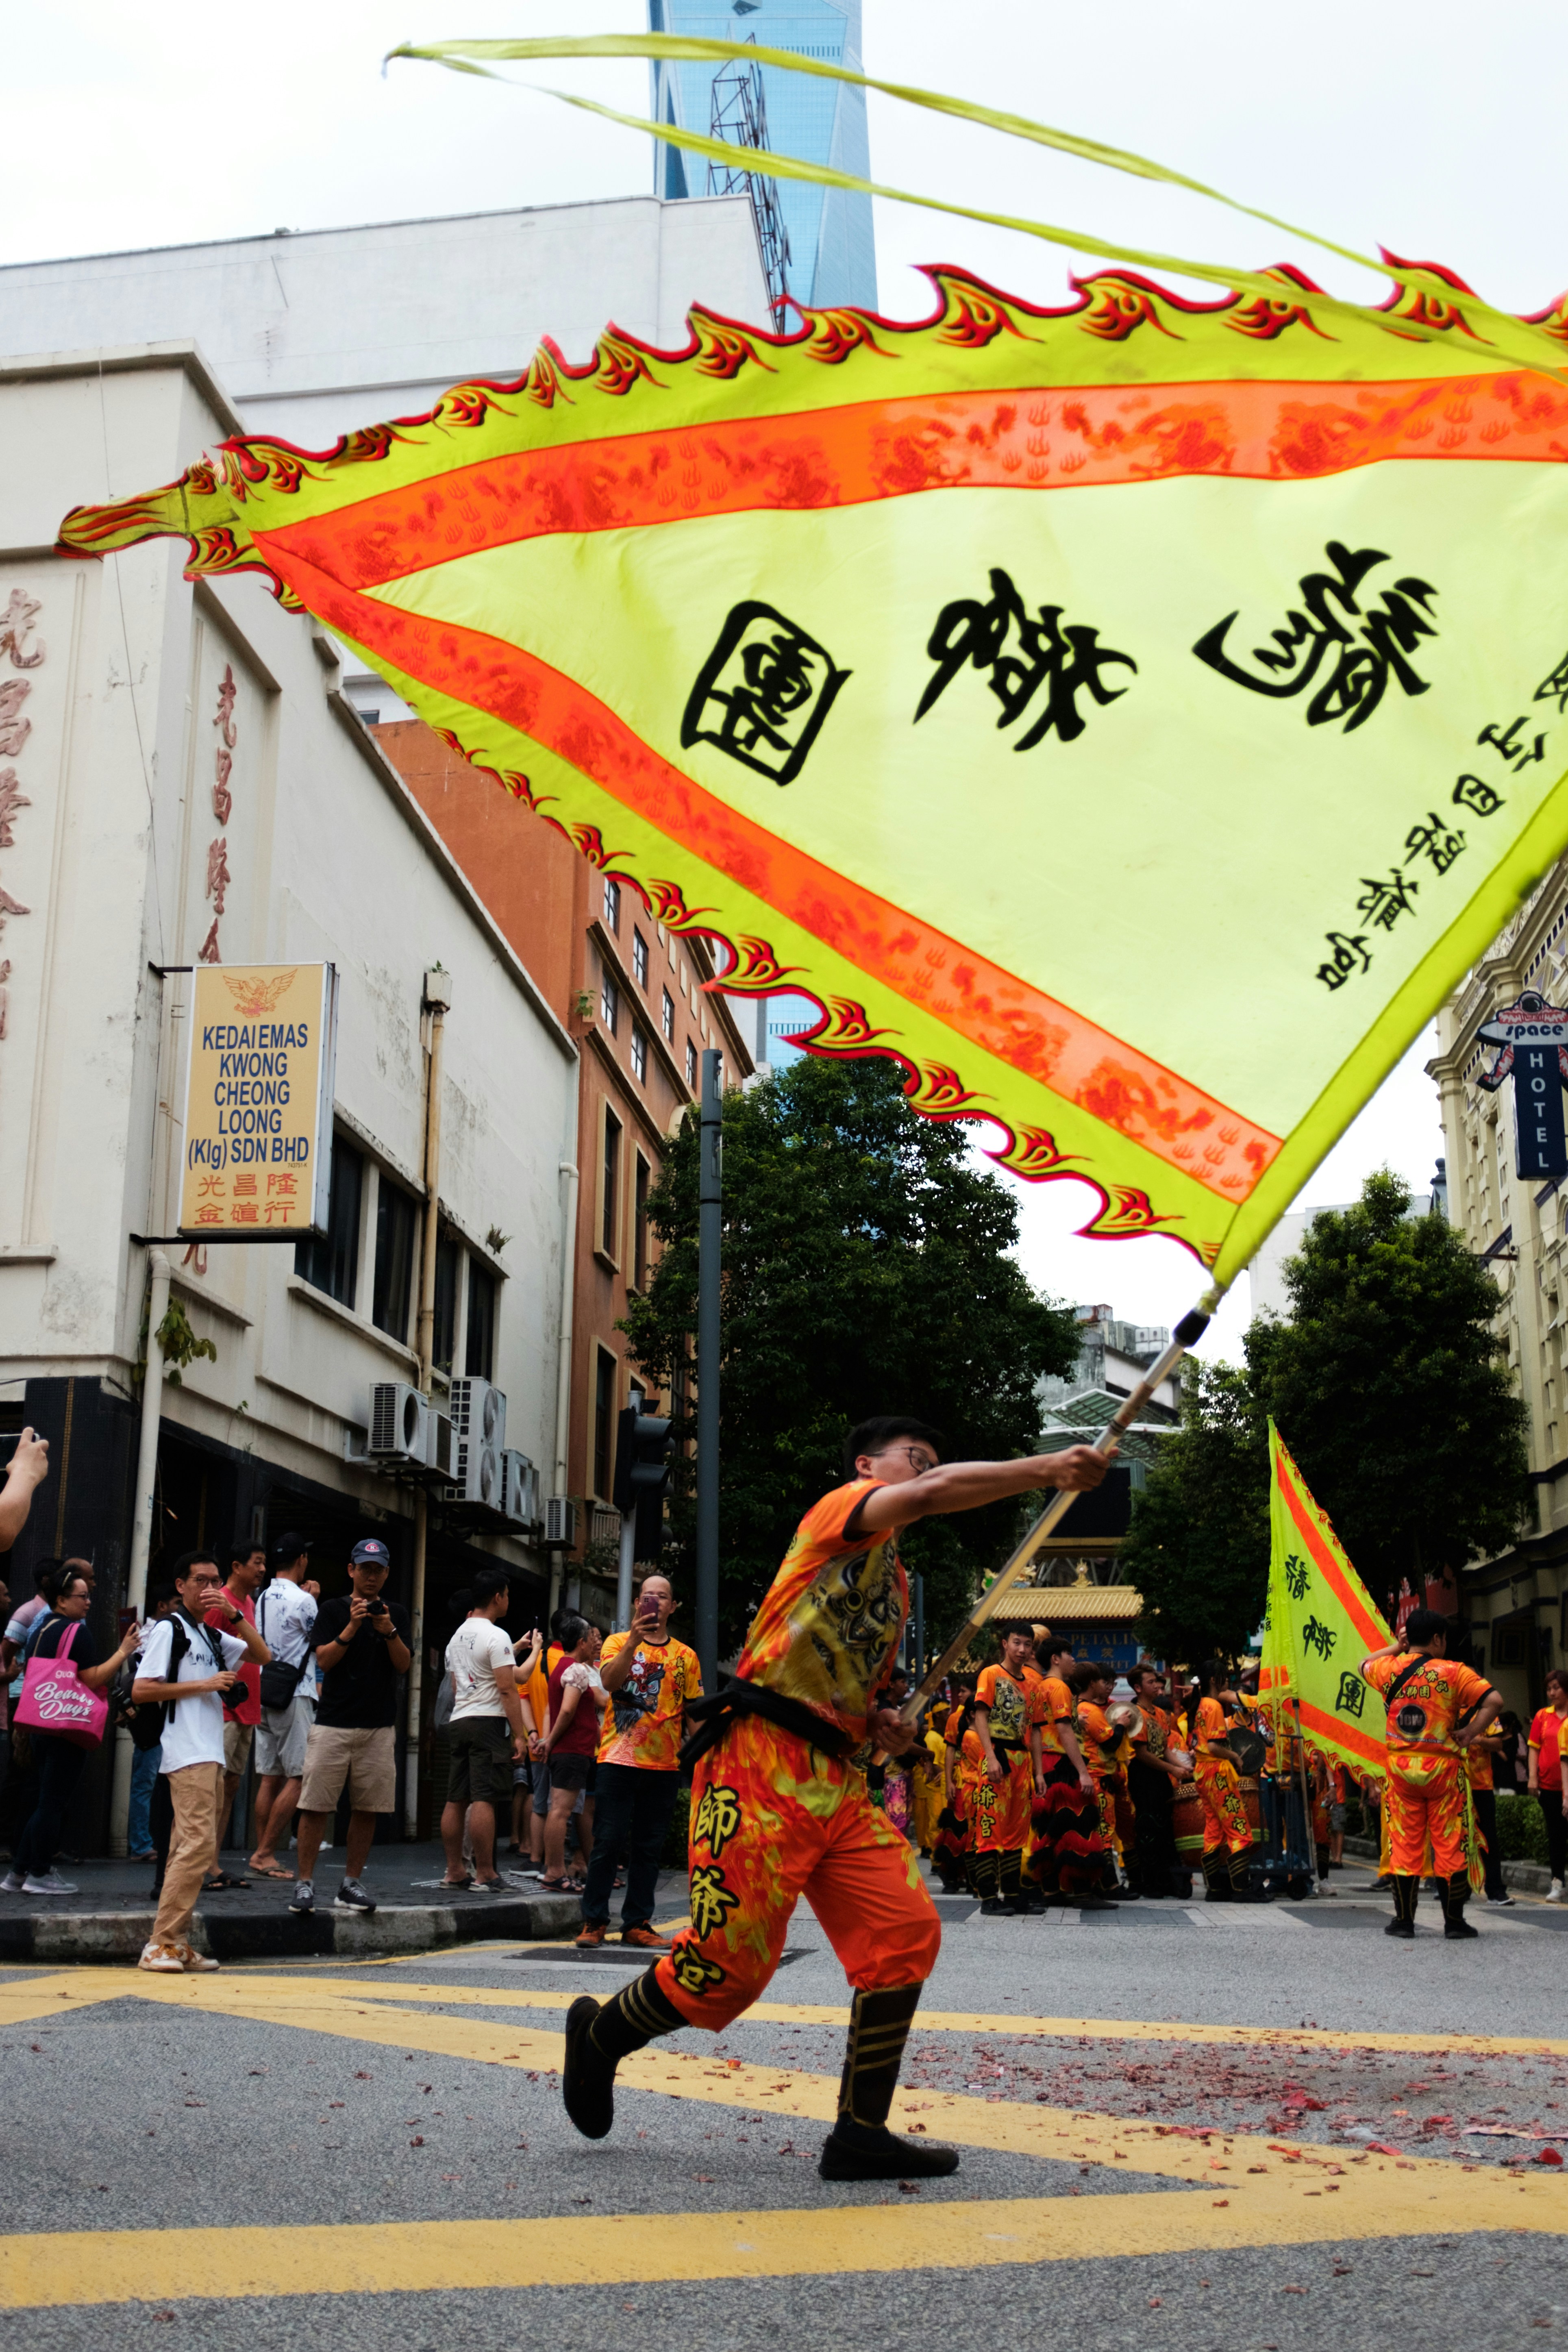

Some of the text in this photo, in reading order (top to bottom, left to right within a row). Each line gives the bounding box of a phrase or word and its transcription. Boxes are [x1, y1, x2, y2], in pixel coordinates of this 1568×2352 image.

[203, 1023, 308, 1050] KEDAI EMAS
[1506, 1025, 1564, 1040] space
[220, 1052, 287, 1077] KWONG
[214, 1080, 289, 1106] CHEONG
[218, 1109, 281, 1134] LOONG
[1529, 1053, 1549, 1168] HOTEL
[231, 1138, 267, 1163] SDN
[272, 1137, 309, 1162] BHD
[197, 1173, 298, 1197] 光昌隆
[1071, 1633, 1141, 1645] PETALIN
[39, 1700, 92, 1719] Days
[673, 1782, 741, 1995] 師爺宮
